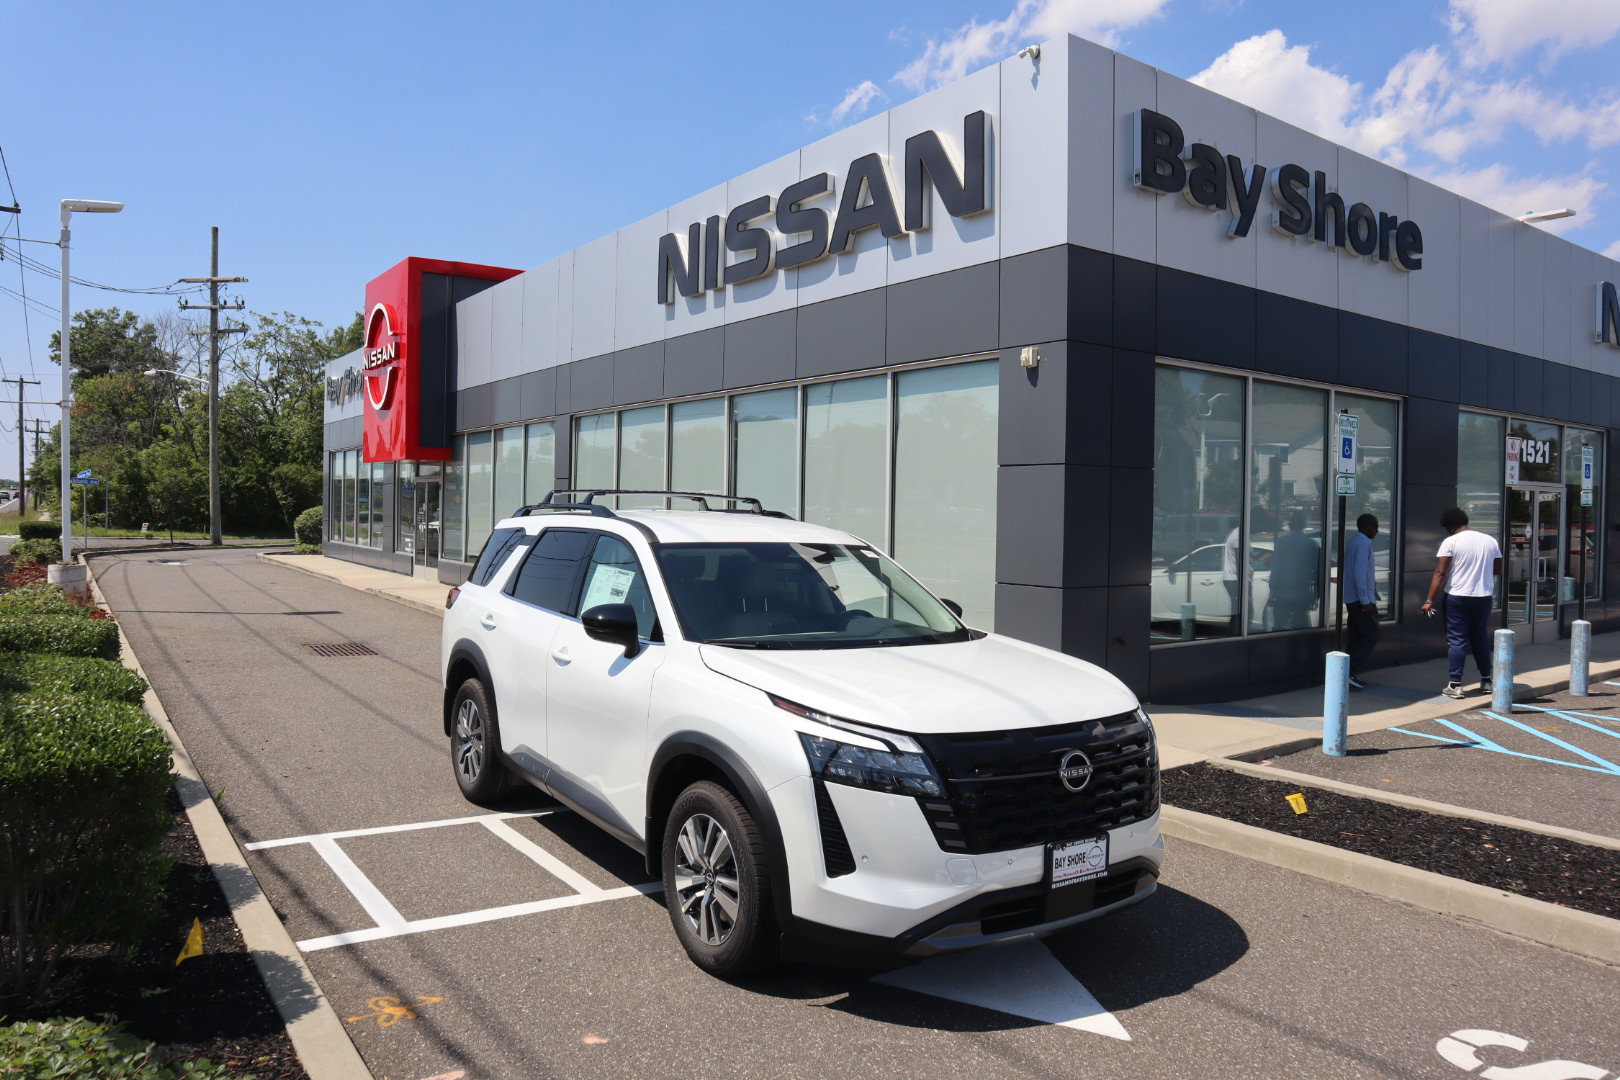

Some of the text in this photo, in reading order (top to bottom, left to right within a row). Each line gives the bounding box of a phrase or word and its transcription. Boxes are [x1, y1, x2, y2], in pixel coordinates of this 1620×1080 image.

[1133, 108, 1424, 272] Bay Shore
[657, 109, 993, 305] NISSAN
[364, 341, 396, 370] NISSAN
[1521, 439, 1550, 464] 1521
[1060, 766, 1093, 778] NISSAN
[1054, 856, 1066, 869] BAY
[1067, 852, 1086, 867] SHORE
